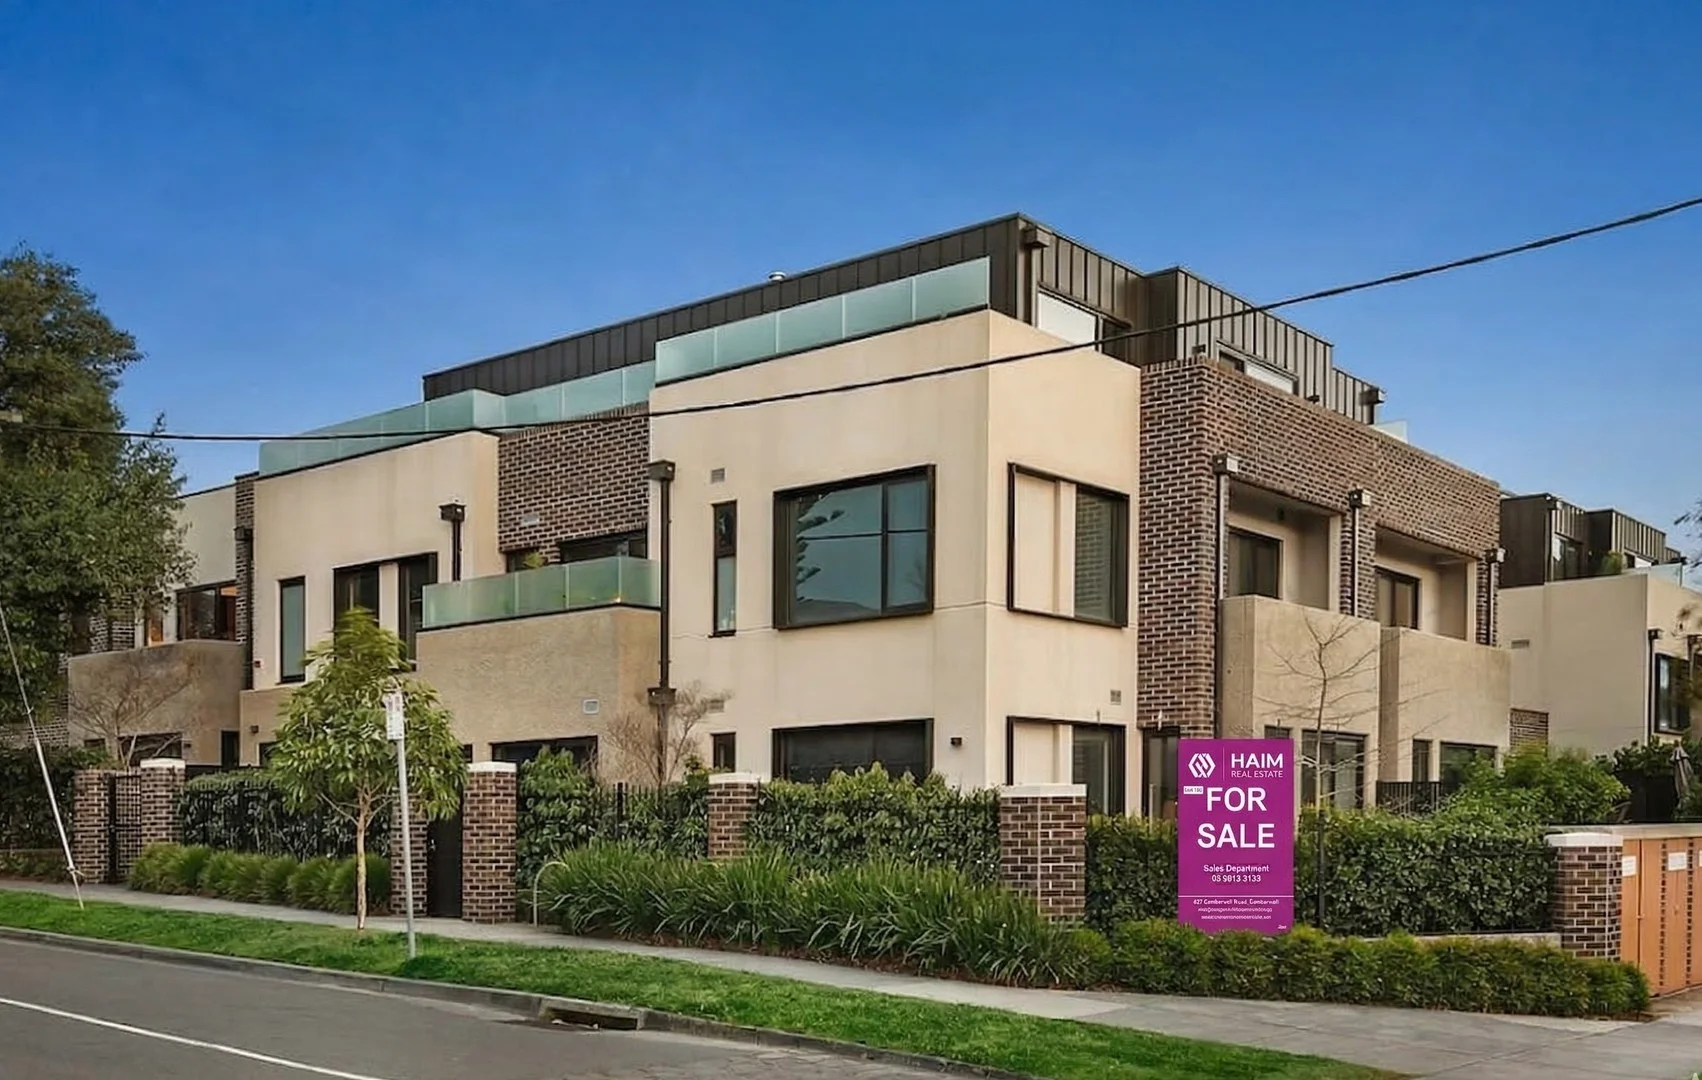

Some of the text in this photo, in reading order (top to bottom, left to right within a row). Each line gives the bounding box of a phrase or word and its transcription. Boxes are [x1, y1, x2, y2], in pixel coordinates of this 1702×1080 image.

[1231, 753, 1283, 769] HAIM
[1231, 770, 1283, 778] REAL ESTATE
[1206, 786, 1267, 812] FOR
[1197, 823, 1275, 849] SALE
[1203, 864, 1269, 873] Sales Department
[1242, 874, 1261, 882] 3133
